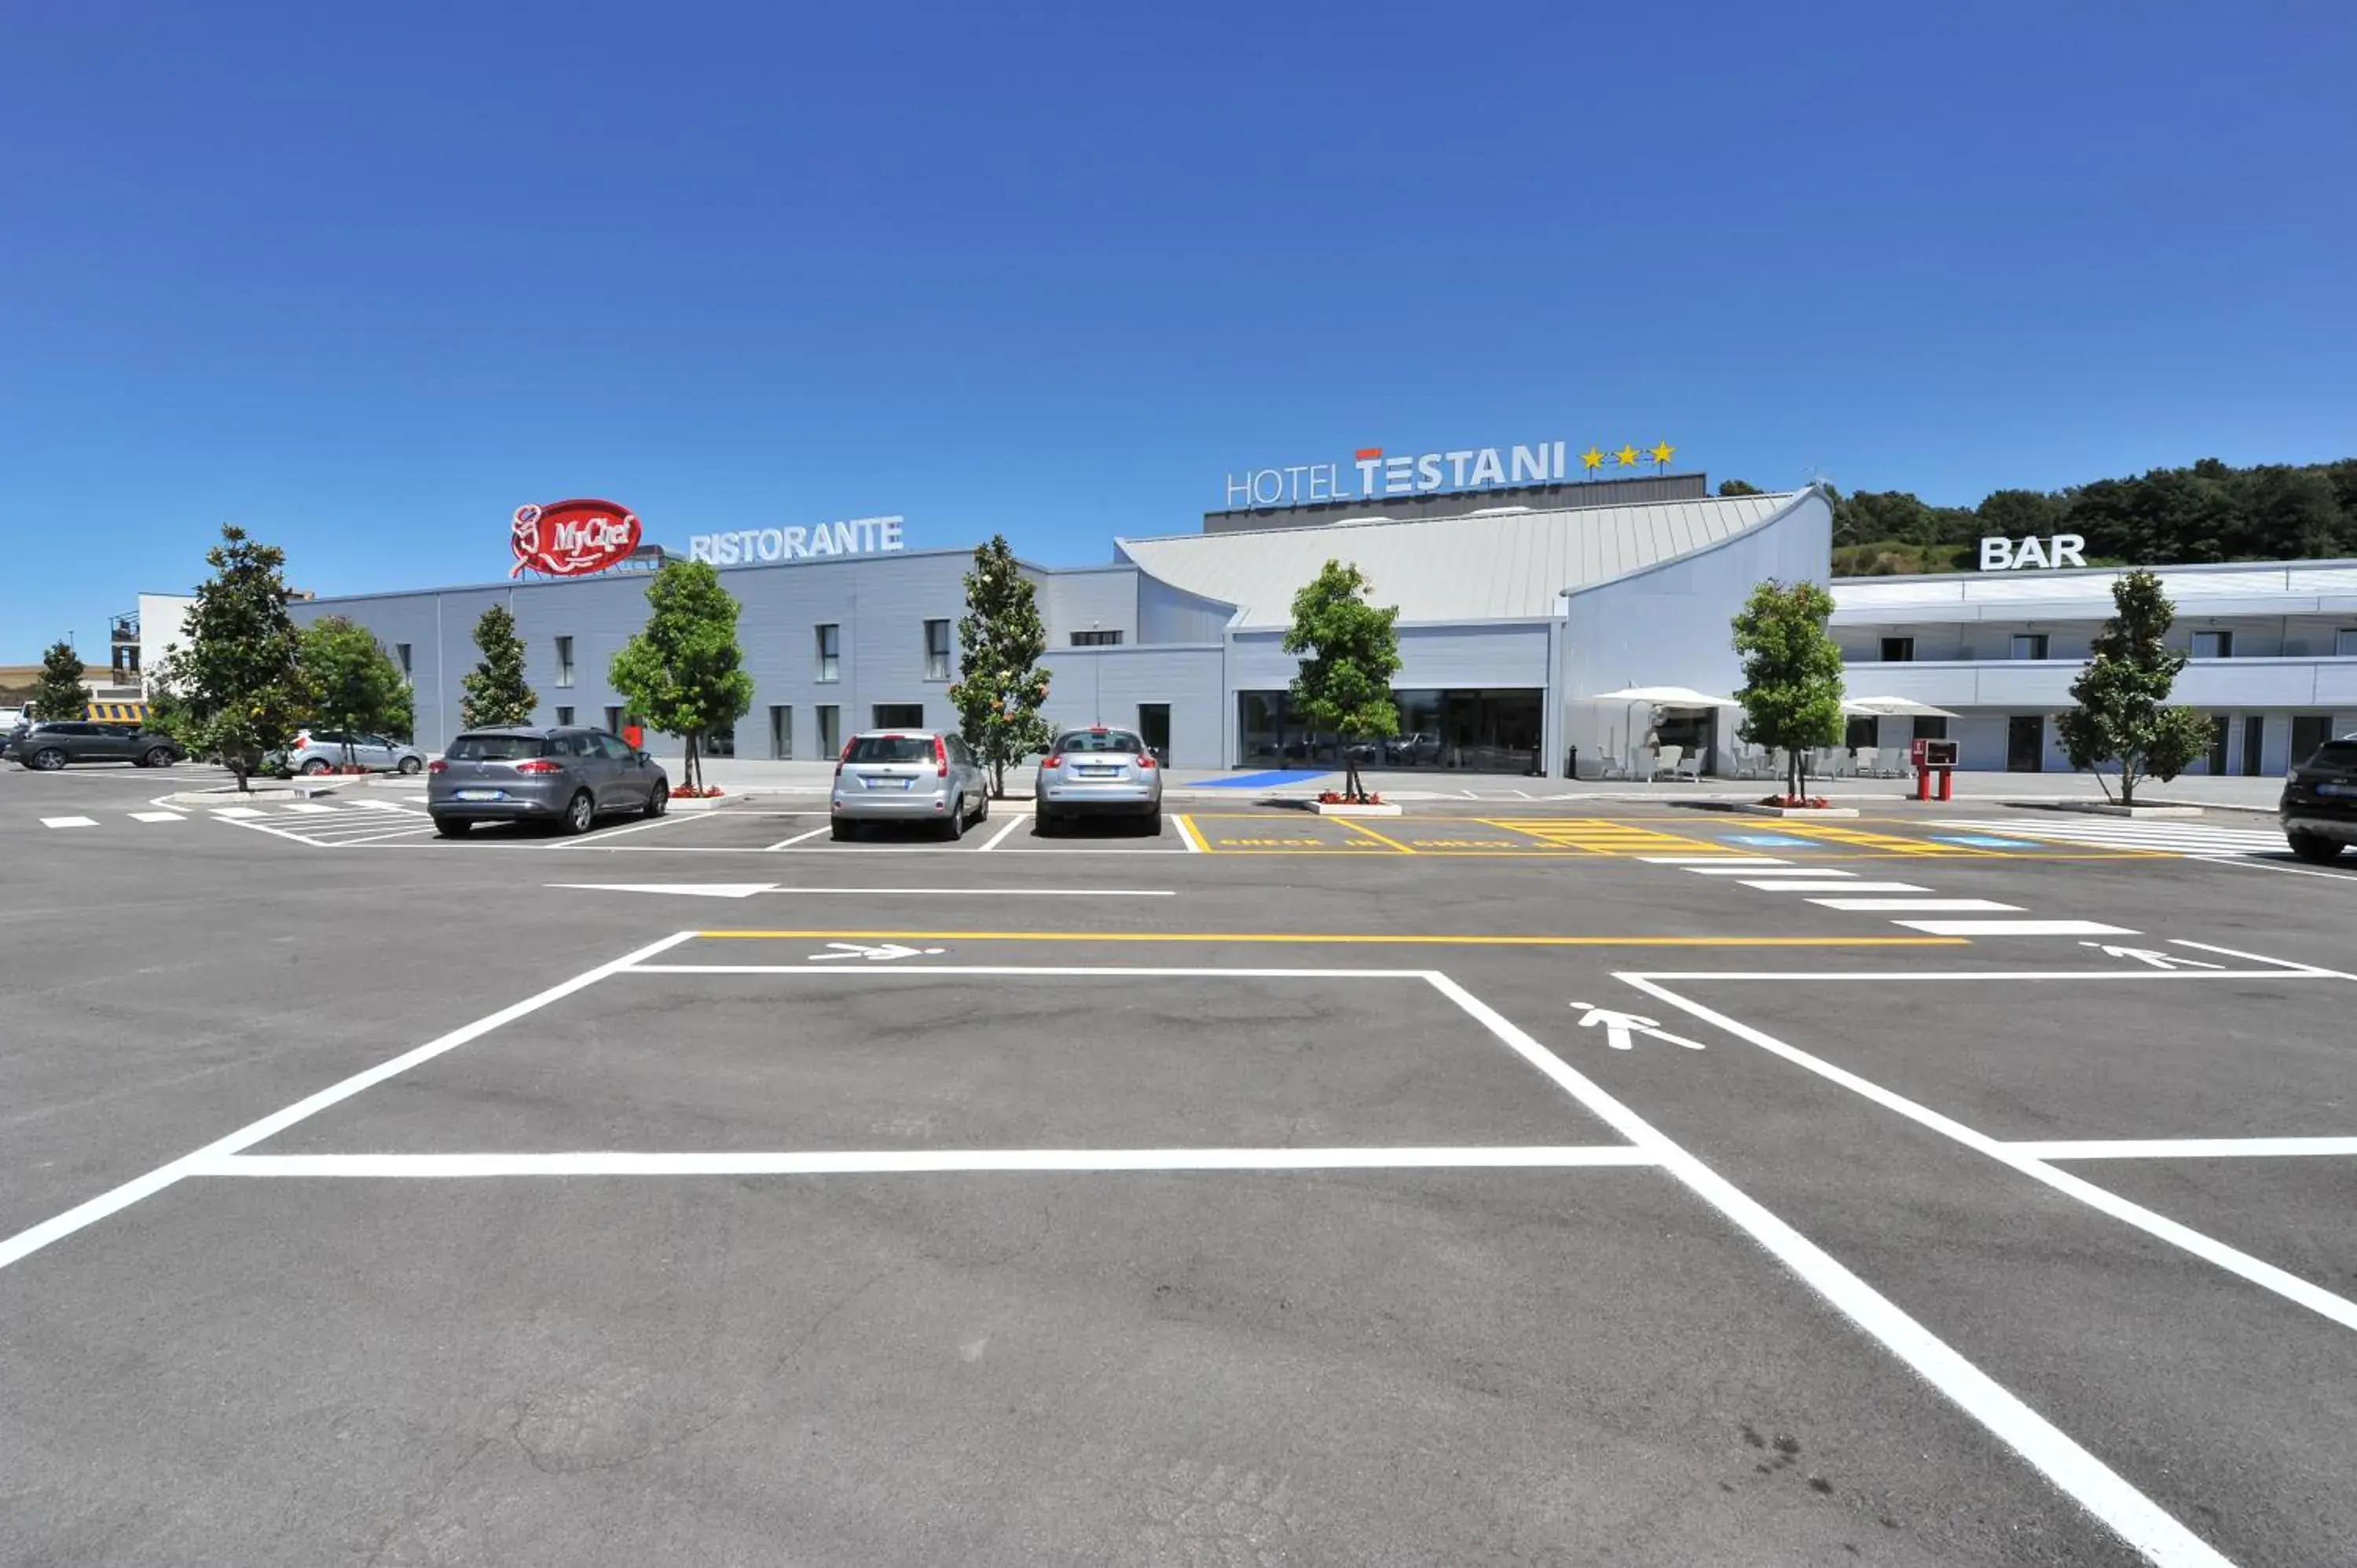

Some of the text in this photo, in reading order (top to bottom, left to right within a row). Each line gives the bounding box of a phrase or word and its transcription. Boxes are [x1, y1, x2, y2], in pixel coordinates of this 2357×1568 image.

[1227, 441, 1565, 507] HOTEL TESTANI
[690, 515, 904, 565] RISTORANTE
[1980, 533, 2088, 570] BAR
